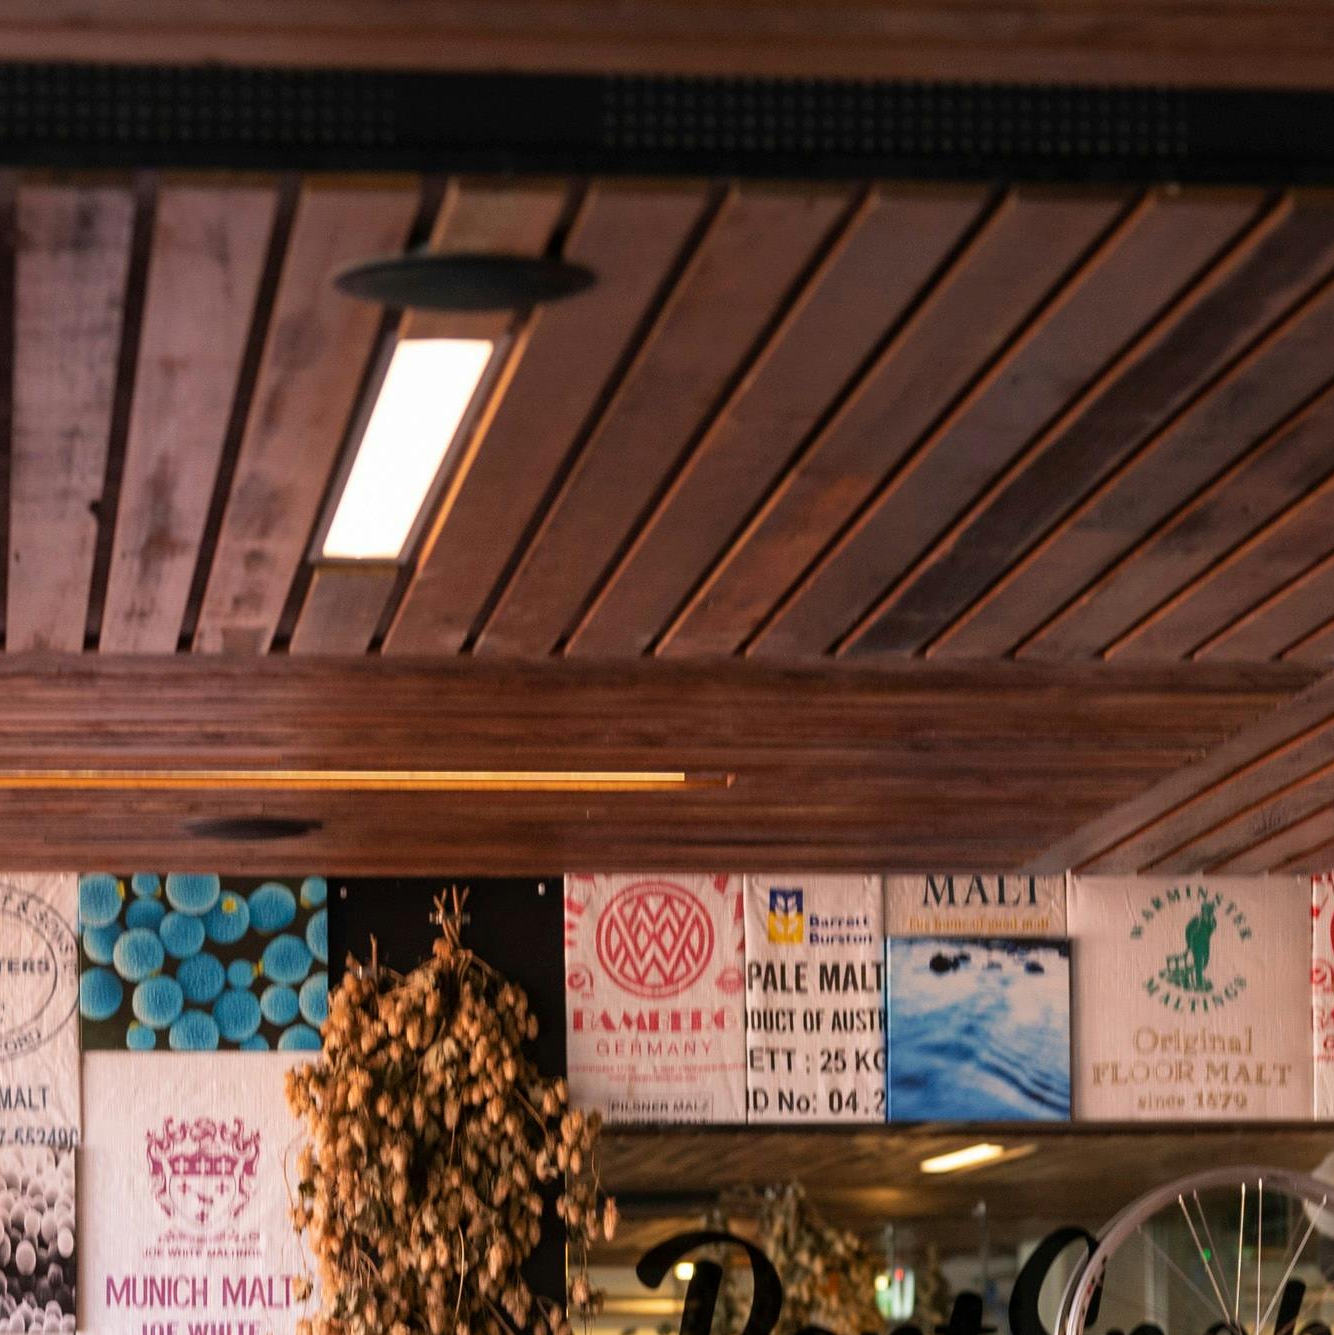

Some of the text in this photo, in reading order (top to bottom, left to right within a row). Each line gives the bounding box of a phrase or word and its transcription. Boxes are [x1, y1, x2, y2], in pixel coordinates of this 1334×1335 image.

[922, 875, 1041, 907] MALT
[809, 915, 870, 929] Barrett
[748, 962, 884, 993] PALE MALT
[1143, 975, 1248, 1014] MALTINGS
[596, 1040, 715, 1058] GERMANY
[1132, 1024, 1254, 1057] Original
[1092, 1061, 1292, 1088] FLOOR MALT
[105, 1275, 293, 1310] MUNICH MALT
